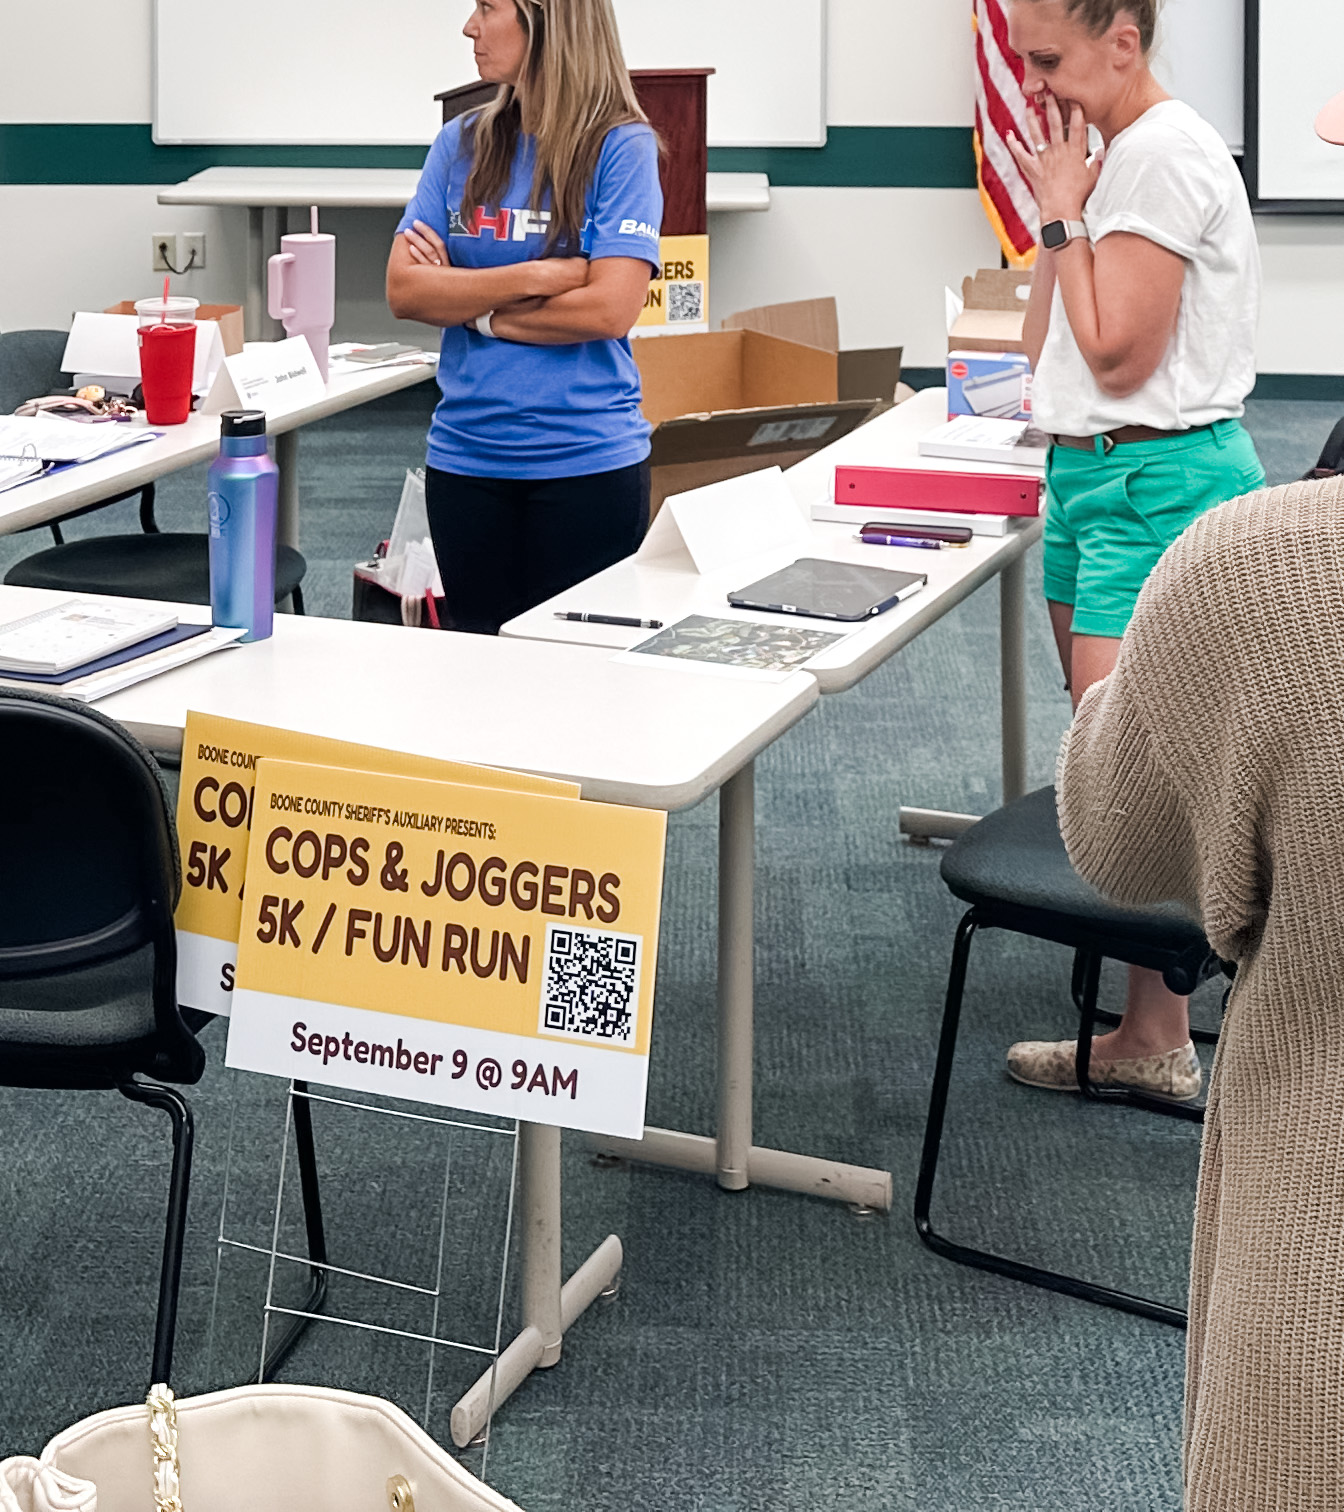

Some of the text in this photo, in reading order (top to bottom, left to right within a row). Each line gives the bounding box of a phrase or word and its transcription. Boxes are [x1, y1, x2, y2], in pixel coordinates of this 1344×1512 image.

[197, 744, 262, 770] BOONE COUN
[193, 776, 255, 832] CO
[270, 792, 497, 840] BOONE COUNTY SHERIFF'S AUXILIARY PRESENTS:
[186, 841, 232, 894] 5K
[265, 826, 621, 924] COPS & JOGGERS
[256, 895, 531, 985] 5K / FUN RUN
[290, 1021, 579, 1100] September 9 @ 9AM
